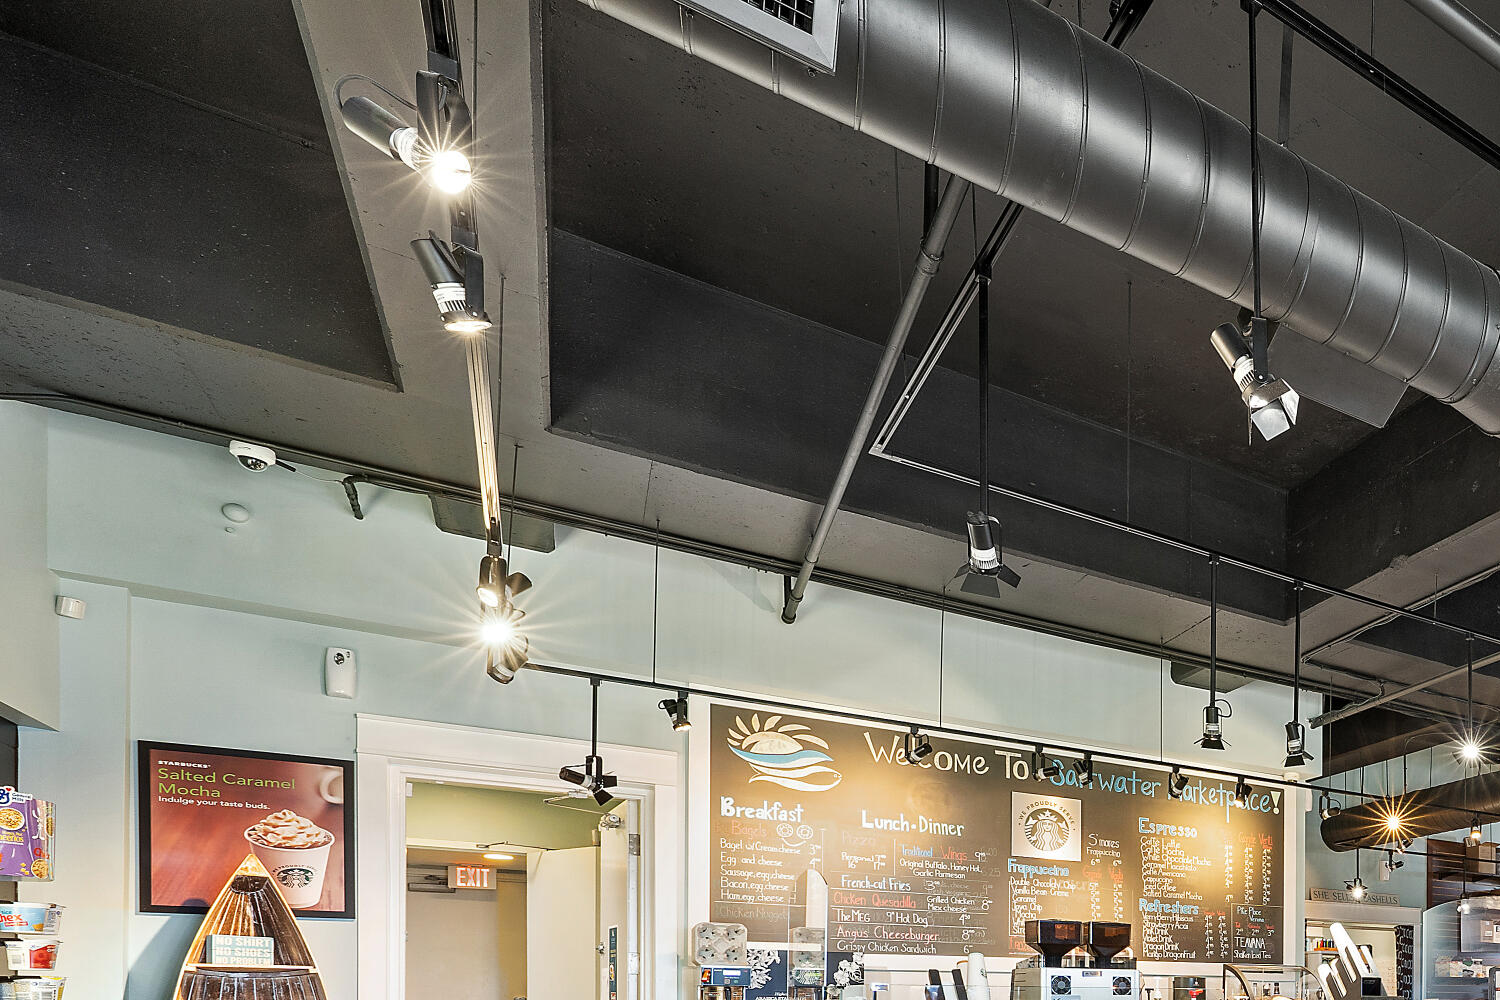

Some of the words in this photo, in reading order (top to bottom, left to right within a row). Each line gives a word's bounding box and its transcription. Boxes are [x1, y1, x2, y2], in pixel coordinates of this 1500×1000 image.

[158, 760, 208, 768] STARBUCKS
[158, 768, 216, 783] Salted
[222, 773, 296, 789] Caramel
[995, 749, 1029, 780] To
[1050, 759, 1161, 797] Sawater
[1168, 780, 1281, 823] arketpce!
[158, 782, 221, 798] Mocha
[158, 796, 194, 805] Indulge
[196, 799, 218, 807] your
[245, 802, 270, 810] buds.
[720, 796, 804, 822] Breakfast
[1019, 810, 1026, 820] WE
[1027, 801, 1057, 810] PROUDLY
[1059, 807, 1075, 824] SERVE
[862, 810, 910, 832] Lunch
[919, 815, 965, 837] Dinner
[1139, 817, 1198, 838] Espresso
[0, 834, 24, 842] eerios
[720, 838, 742, 852] Bagel
[720, 852, 736, 866] Egg
[742, 855, 755, 864] and
[758, 858, 783, 866] cheese
[941, 846, 968, 864] Wings
[457, 868, 489, 887] EXIT
[913, 869, 934, 877] Garlic
[935, 870, 965, 879] Parmesan
[841, 875, 886, 890] French-cut
[889, 878, 911, 891] Fries
[833, 892, 866, 905] Chicken
[872, 894, 916, 909] Quesadilla
[927, 896, 948, 904] Grilled
[951, 897, 975, 906] Chicken
[1313, 891, 1329, 899] SHE
[1332, 892, 1352, 901] SELL
[1139, 898, 1199, 915] Refreshers
[836, 909, 851, 922] The
[895, 913, 911, 923] Hot
[913, 914, 928, 927] Dog
[216, 937, 232, 946] NO
[236, 938, 271, 947] SHIRT
[837, 928, 869, 943] Angus
[874, 926, 939, 944] Cheeseburger
[216, 947, 232, 955] NO
[235, 948, 270, 957] SHOES
[837, 940, 865, 952] Crispy
[868, 941, 899, 952] Chicken
[901, 944, 936, 954] Sandwich
[231, 957, 271, 965] PROBLEM
